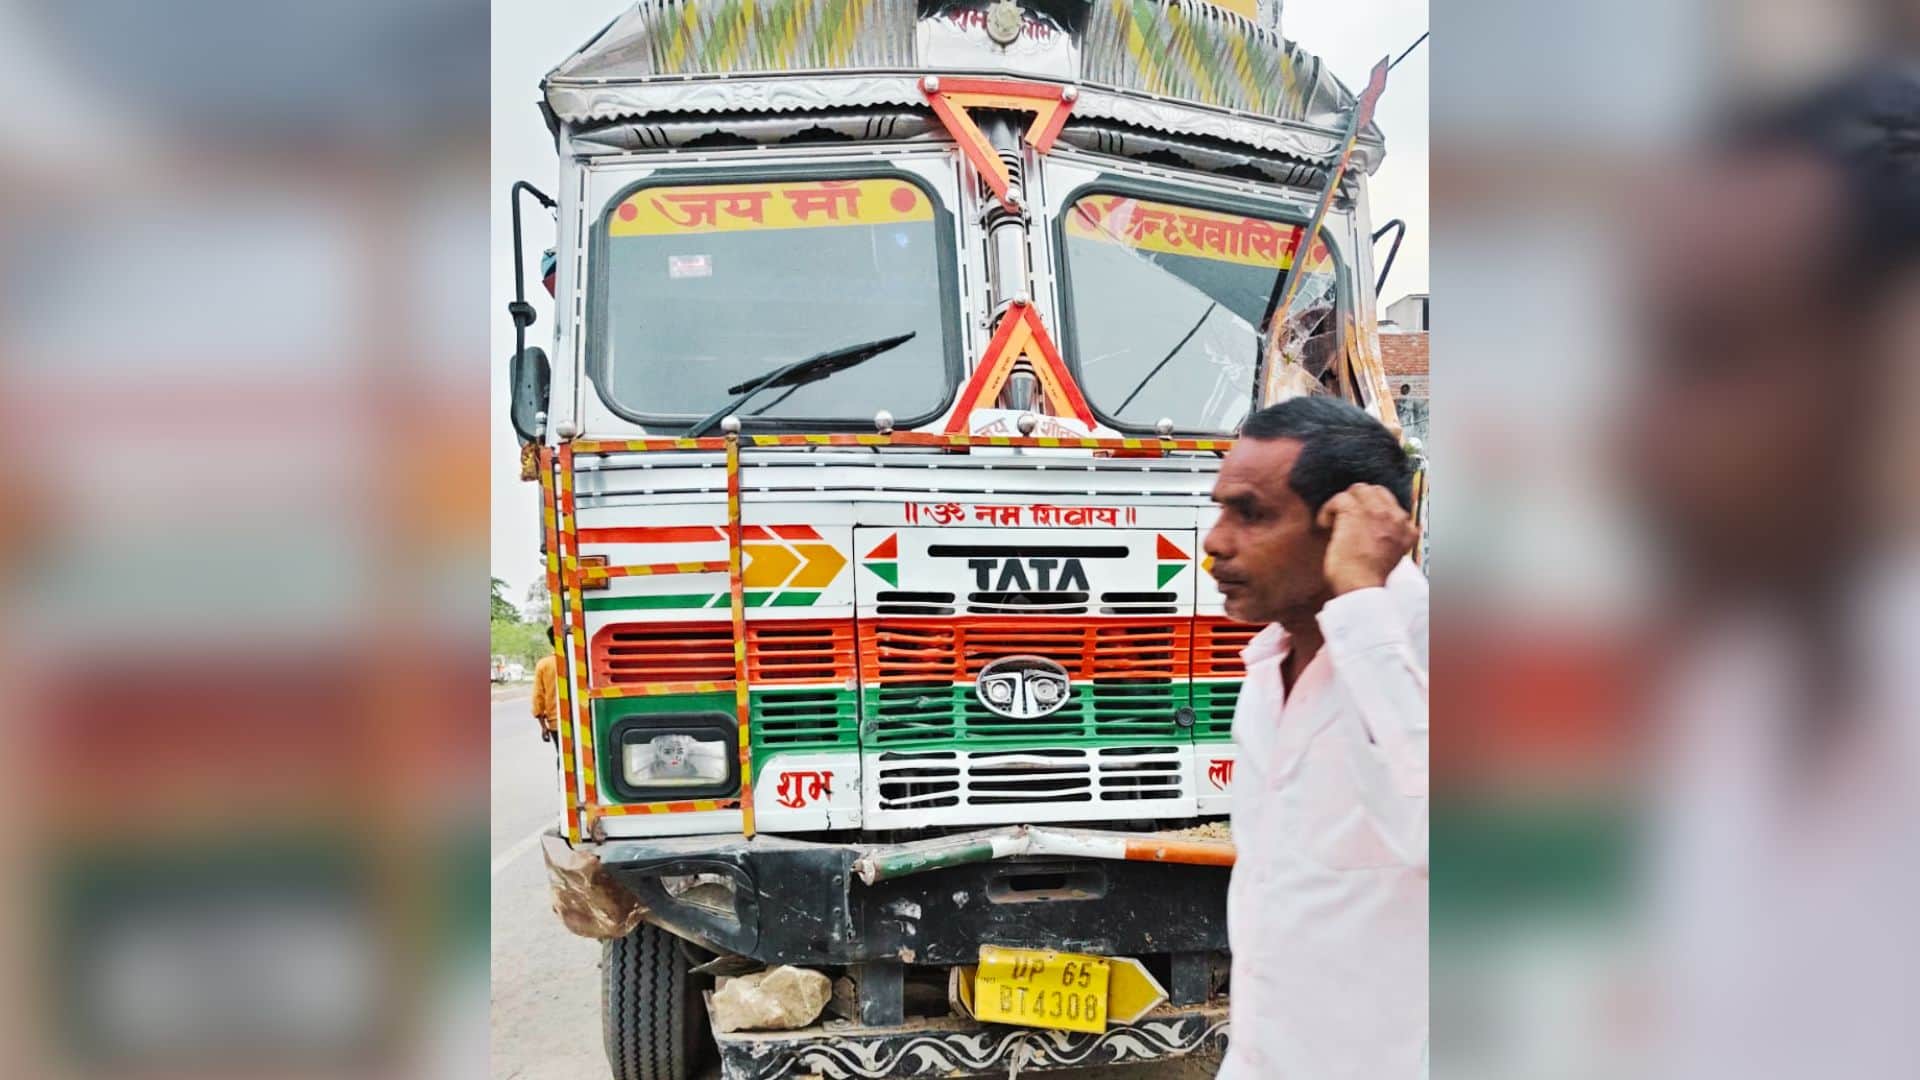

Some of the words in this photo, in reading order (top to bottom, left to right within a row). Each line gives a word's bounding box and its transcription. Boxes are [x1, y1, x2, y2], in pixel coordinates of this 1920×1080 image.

[651, 191, 772, 227] जय
[924, 502, 965, 524] ॐ
[974, 505, 1020, 526] नम
[1028, 504, 1120, 526] शिवाय
[968, 558, 1090, 591] TATA
[776, 771, 834, 808] शुभ
[1208, 759, 1234, 791] ला
[1012, 957, 1045, 983] UP
[1062, 961, 1093, 988] 65
[999, 984, 1099, 1023] BT4308
